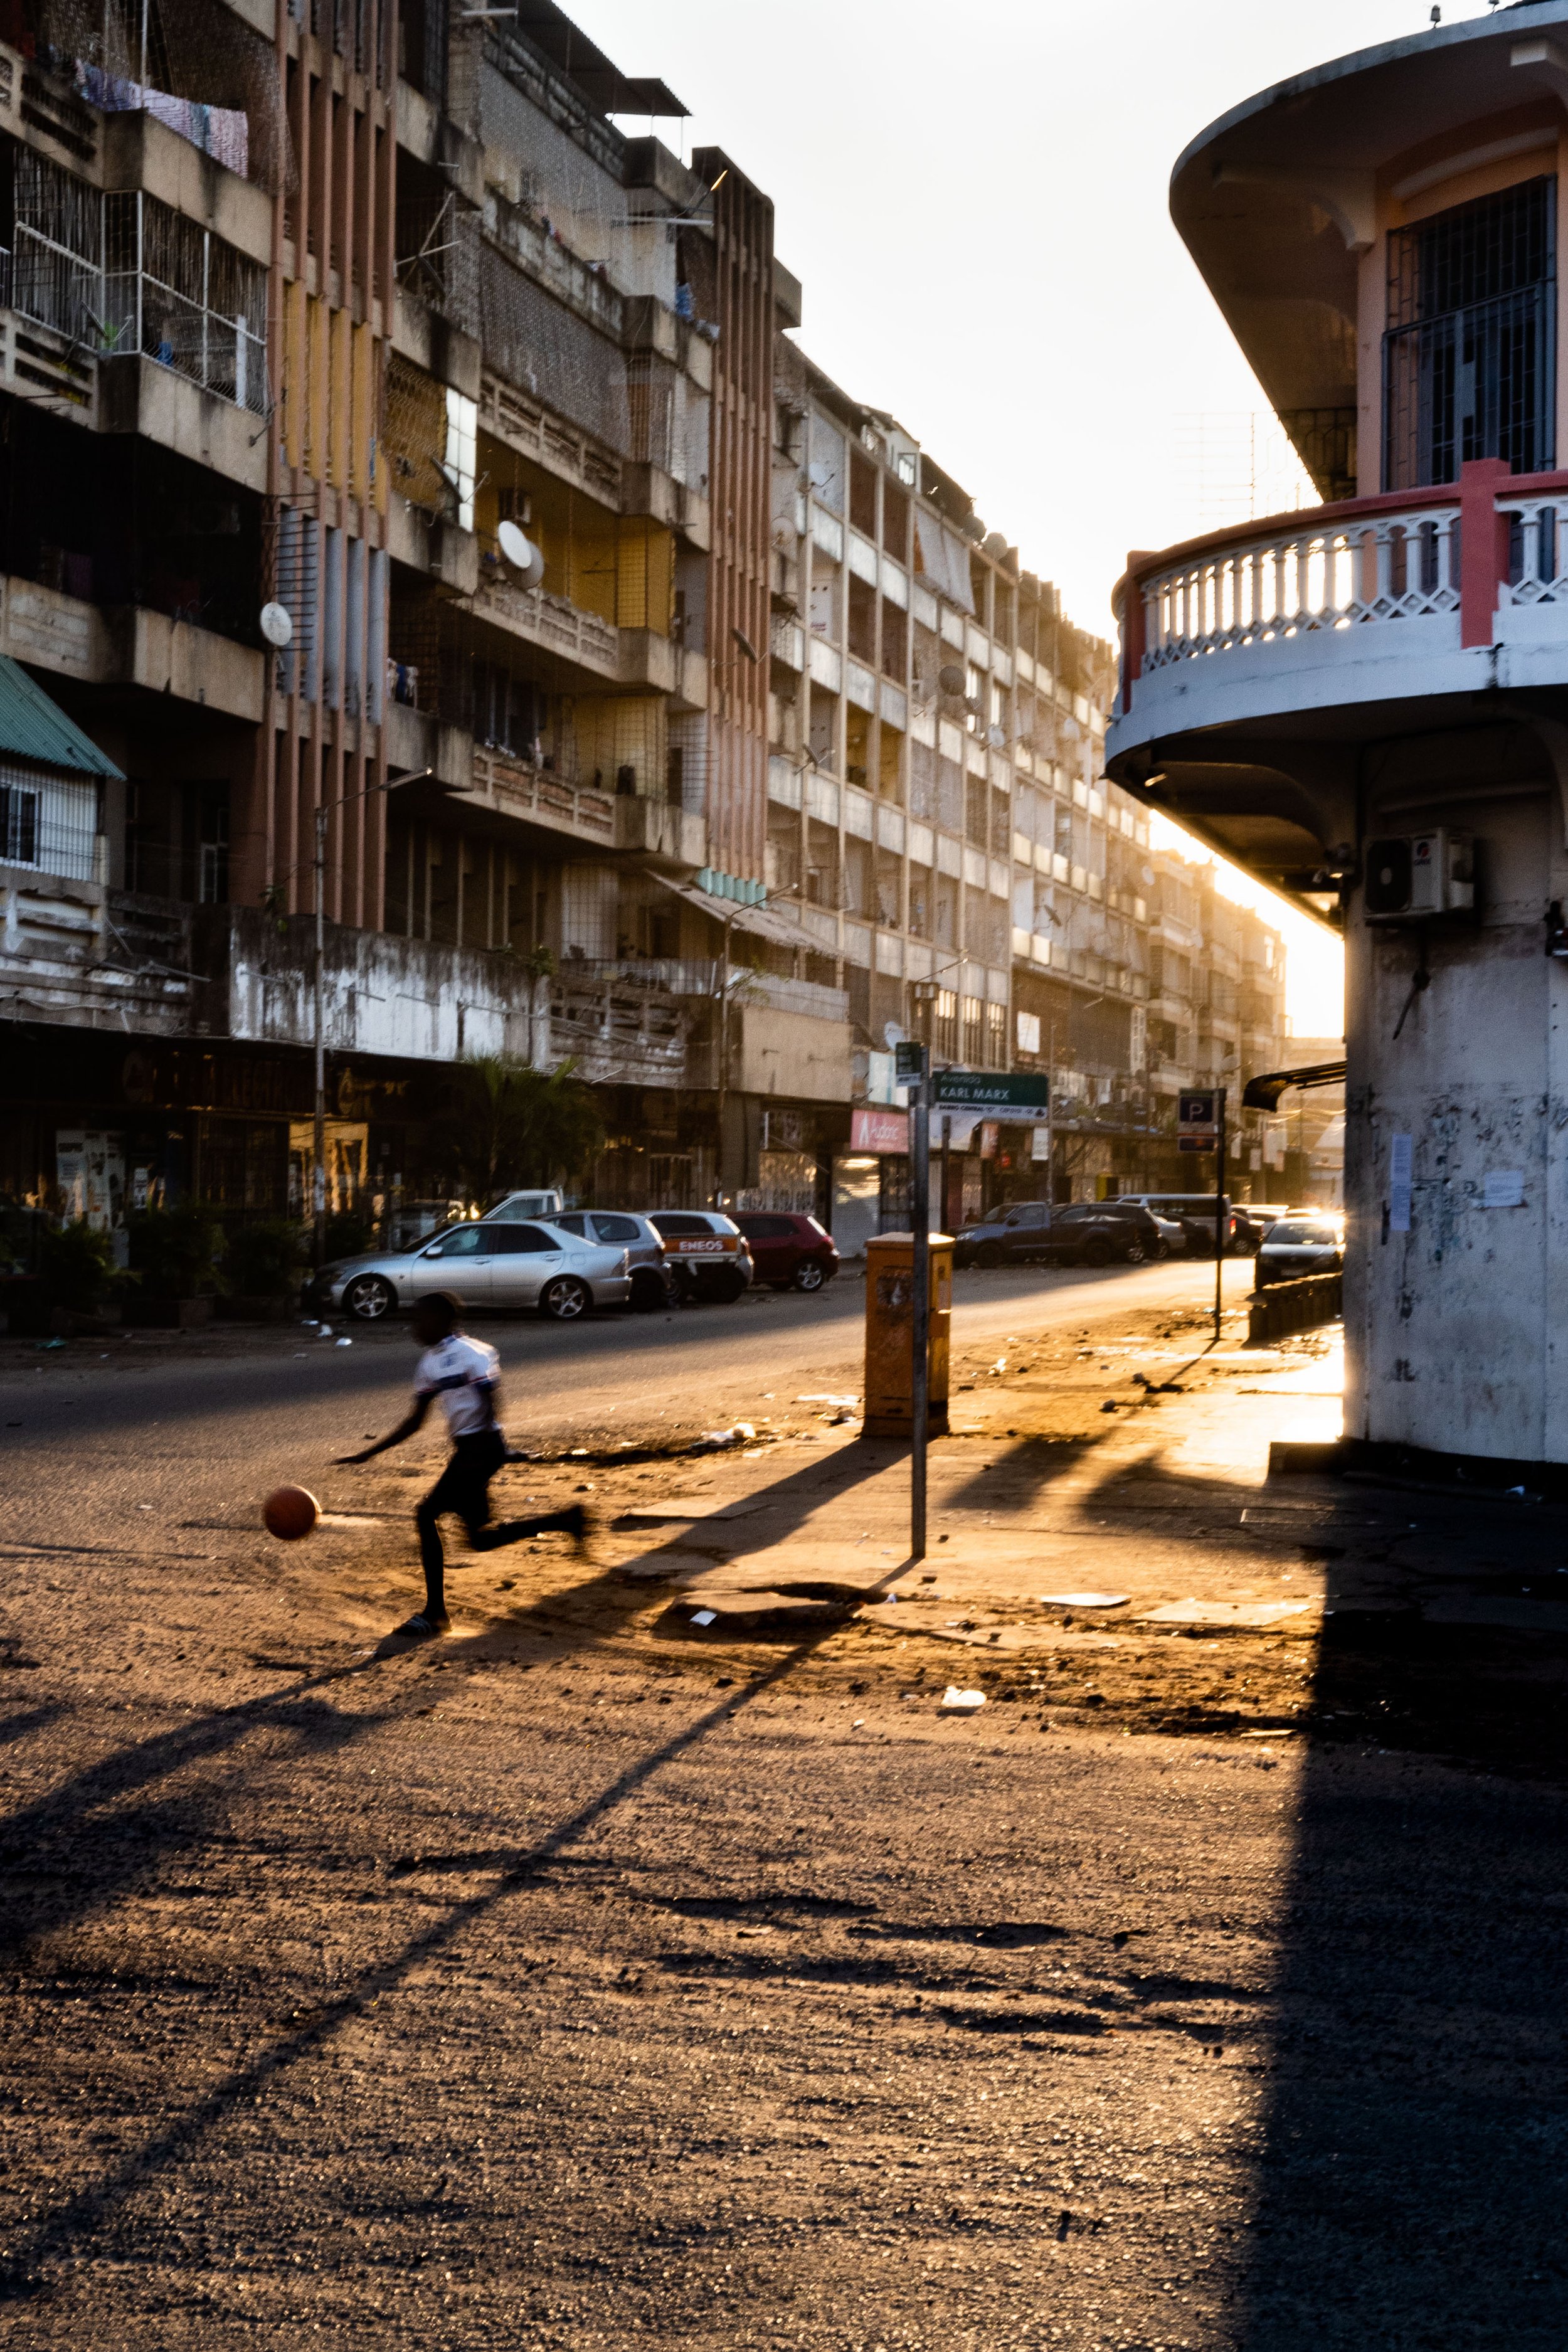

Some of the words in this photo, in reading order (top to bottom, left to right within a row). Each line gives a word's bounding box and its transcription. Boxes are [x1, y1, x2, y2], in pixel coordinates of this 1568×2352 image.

[940, 1086, 970, 1099] KARL
[973, 1088, 1010, 1100] MARX
[1190, 1104, 1204, 1121] P
[679, 1241, 723, 1251] ENEOS
